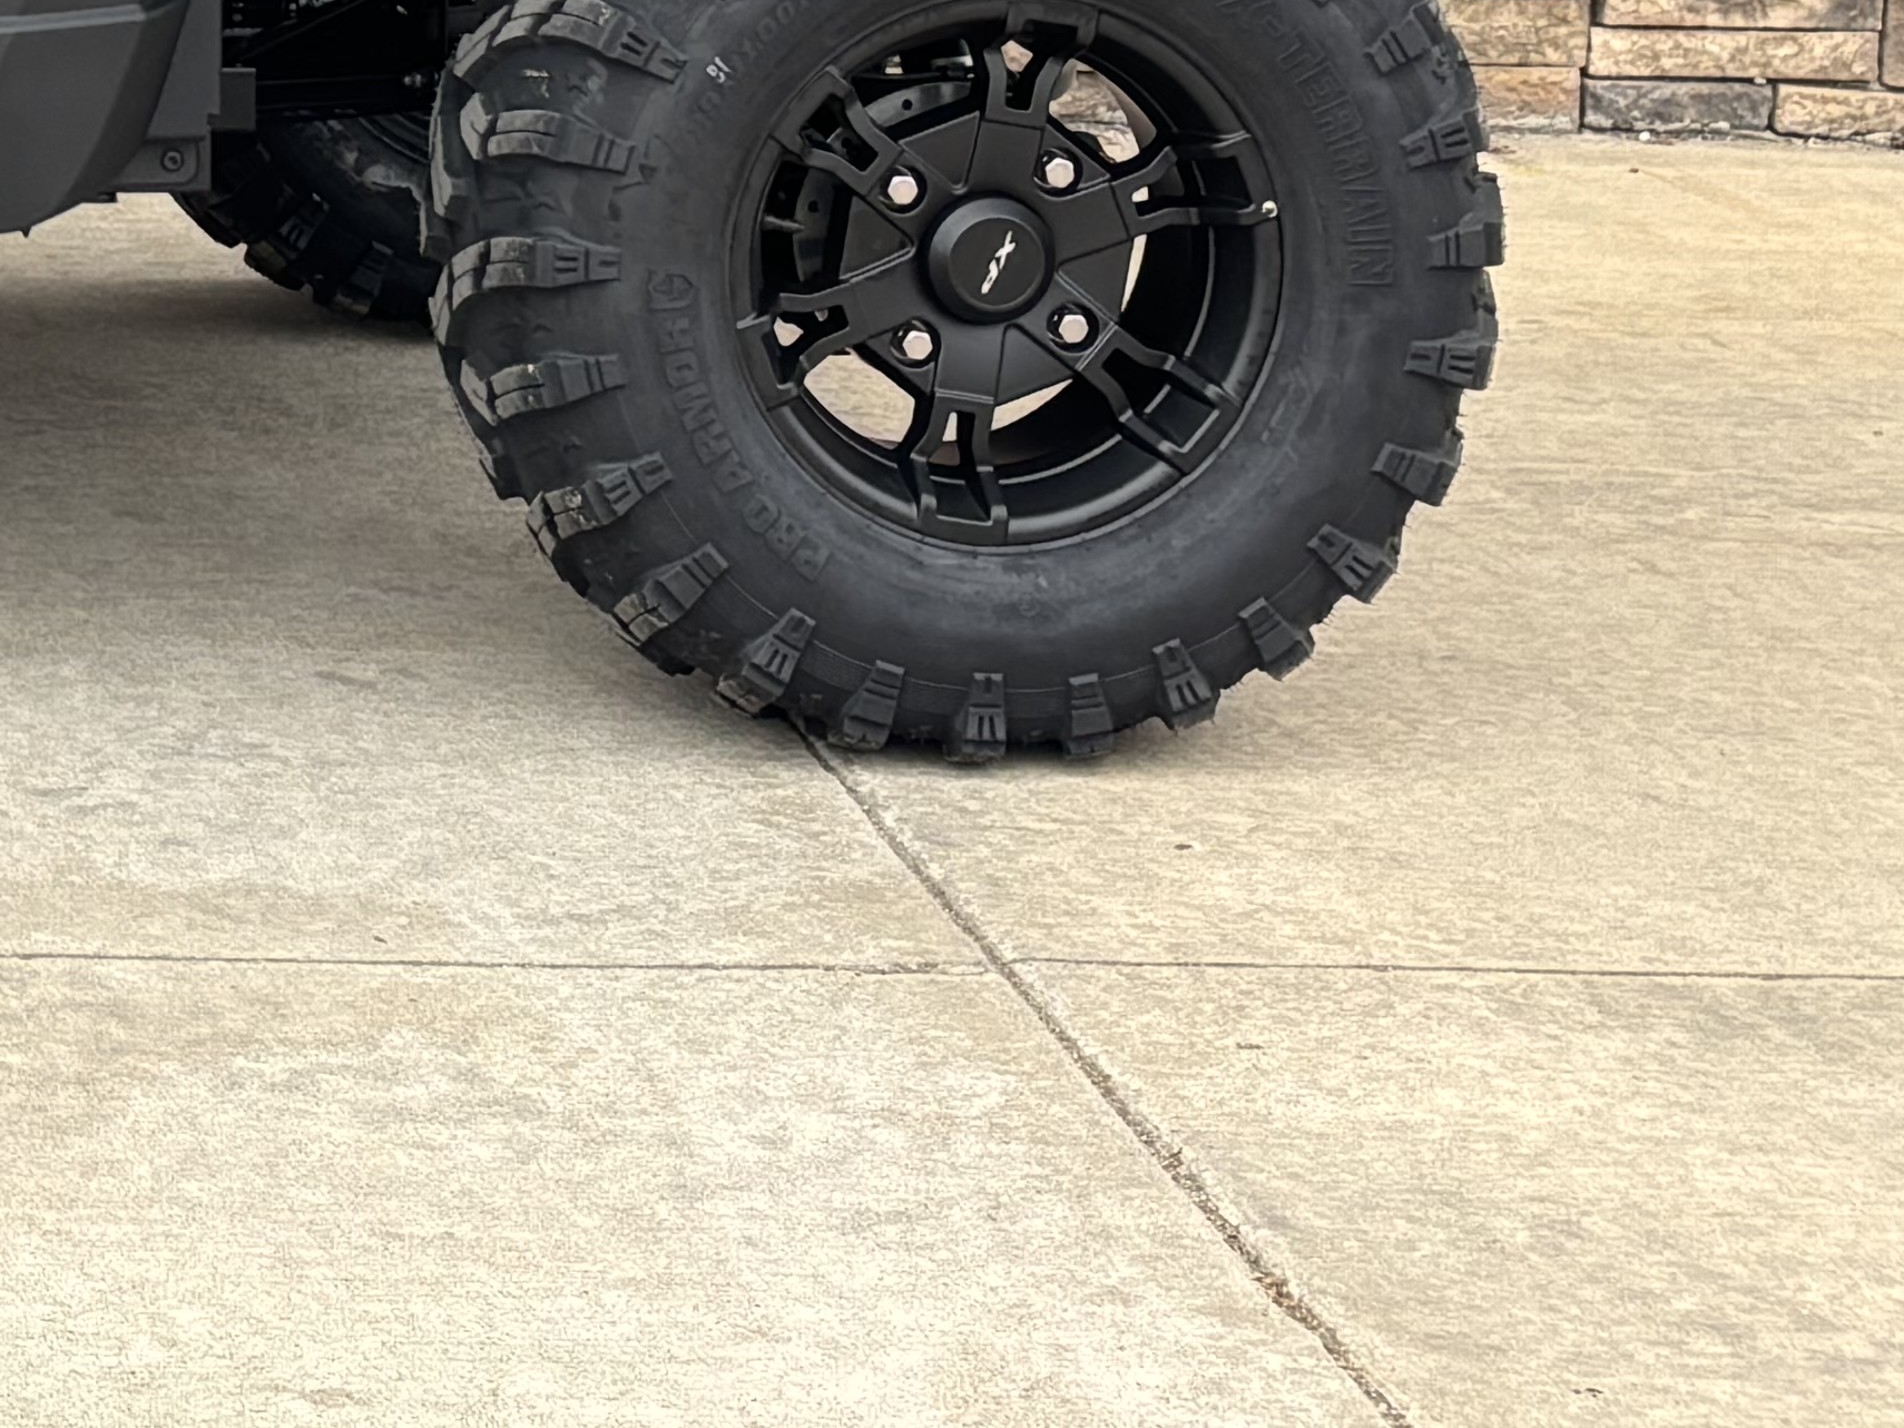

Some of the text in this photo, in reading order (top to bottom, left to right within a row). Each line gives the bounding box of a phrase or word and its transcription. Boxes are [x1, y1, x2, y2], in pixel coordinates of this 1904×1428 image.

[981, 230, 1016, 295] XP
[657, 317, 832, 582] PRO ARMOR
